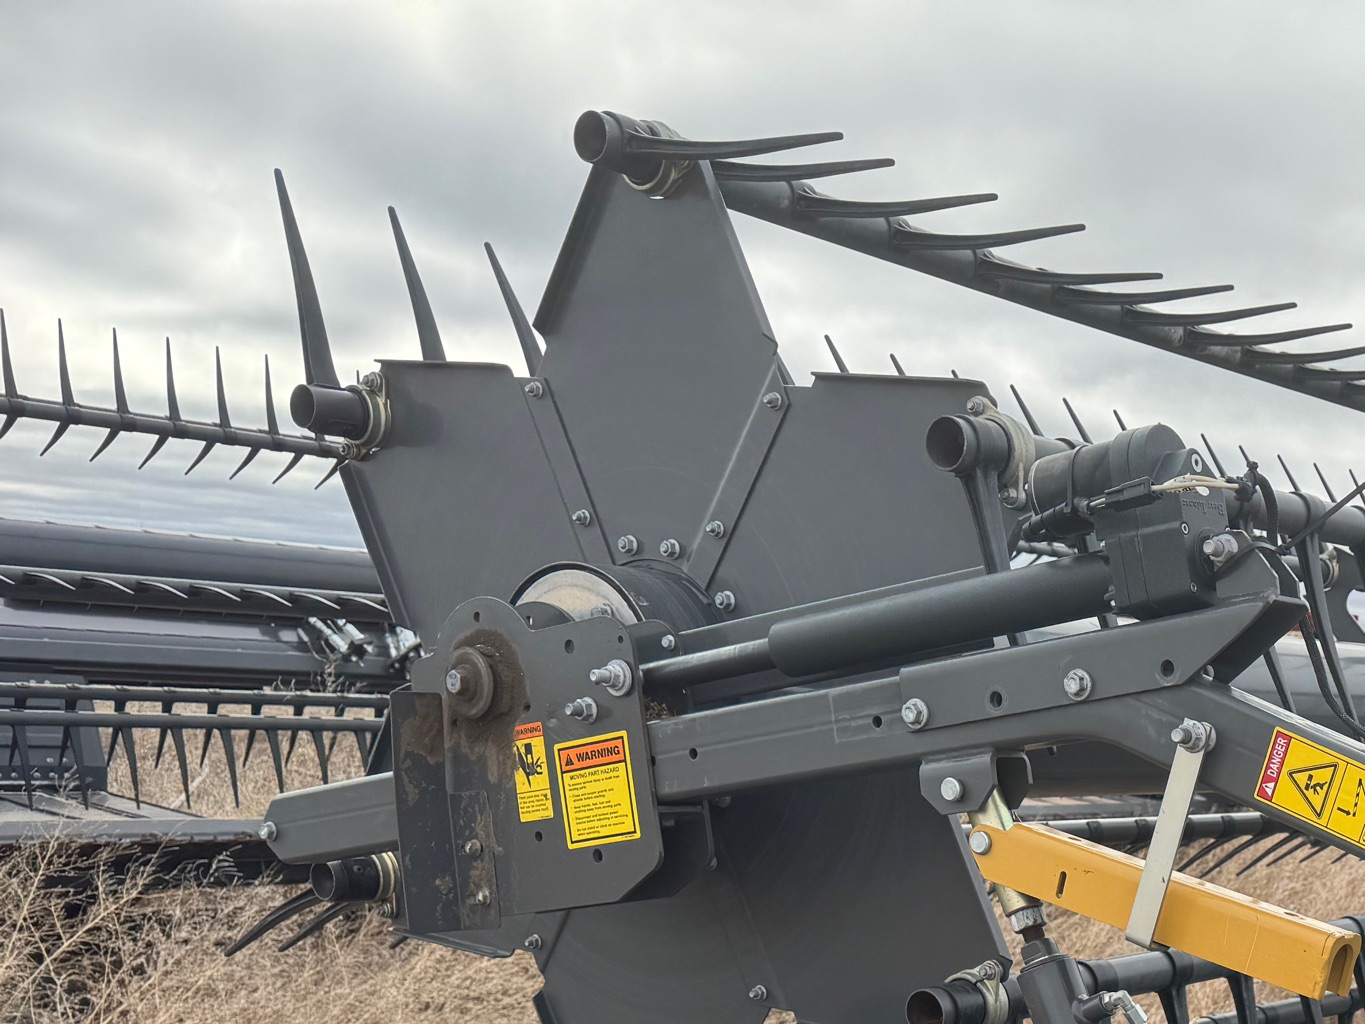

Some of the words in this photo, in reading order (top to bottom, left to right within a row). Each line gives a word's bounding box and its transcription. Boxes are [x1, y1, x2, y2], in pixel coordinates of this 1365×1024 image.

[575, 745, 621, 763] WARNING
[1267, 737, 1288, 778] DANGER
[569, 772, 588, 781] MOVING
[588, 769, 600, 778] PART
[600, 766, 620, 776] HAZARD
